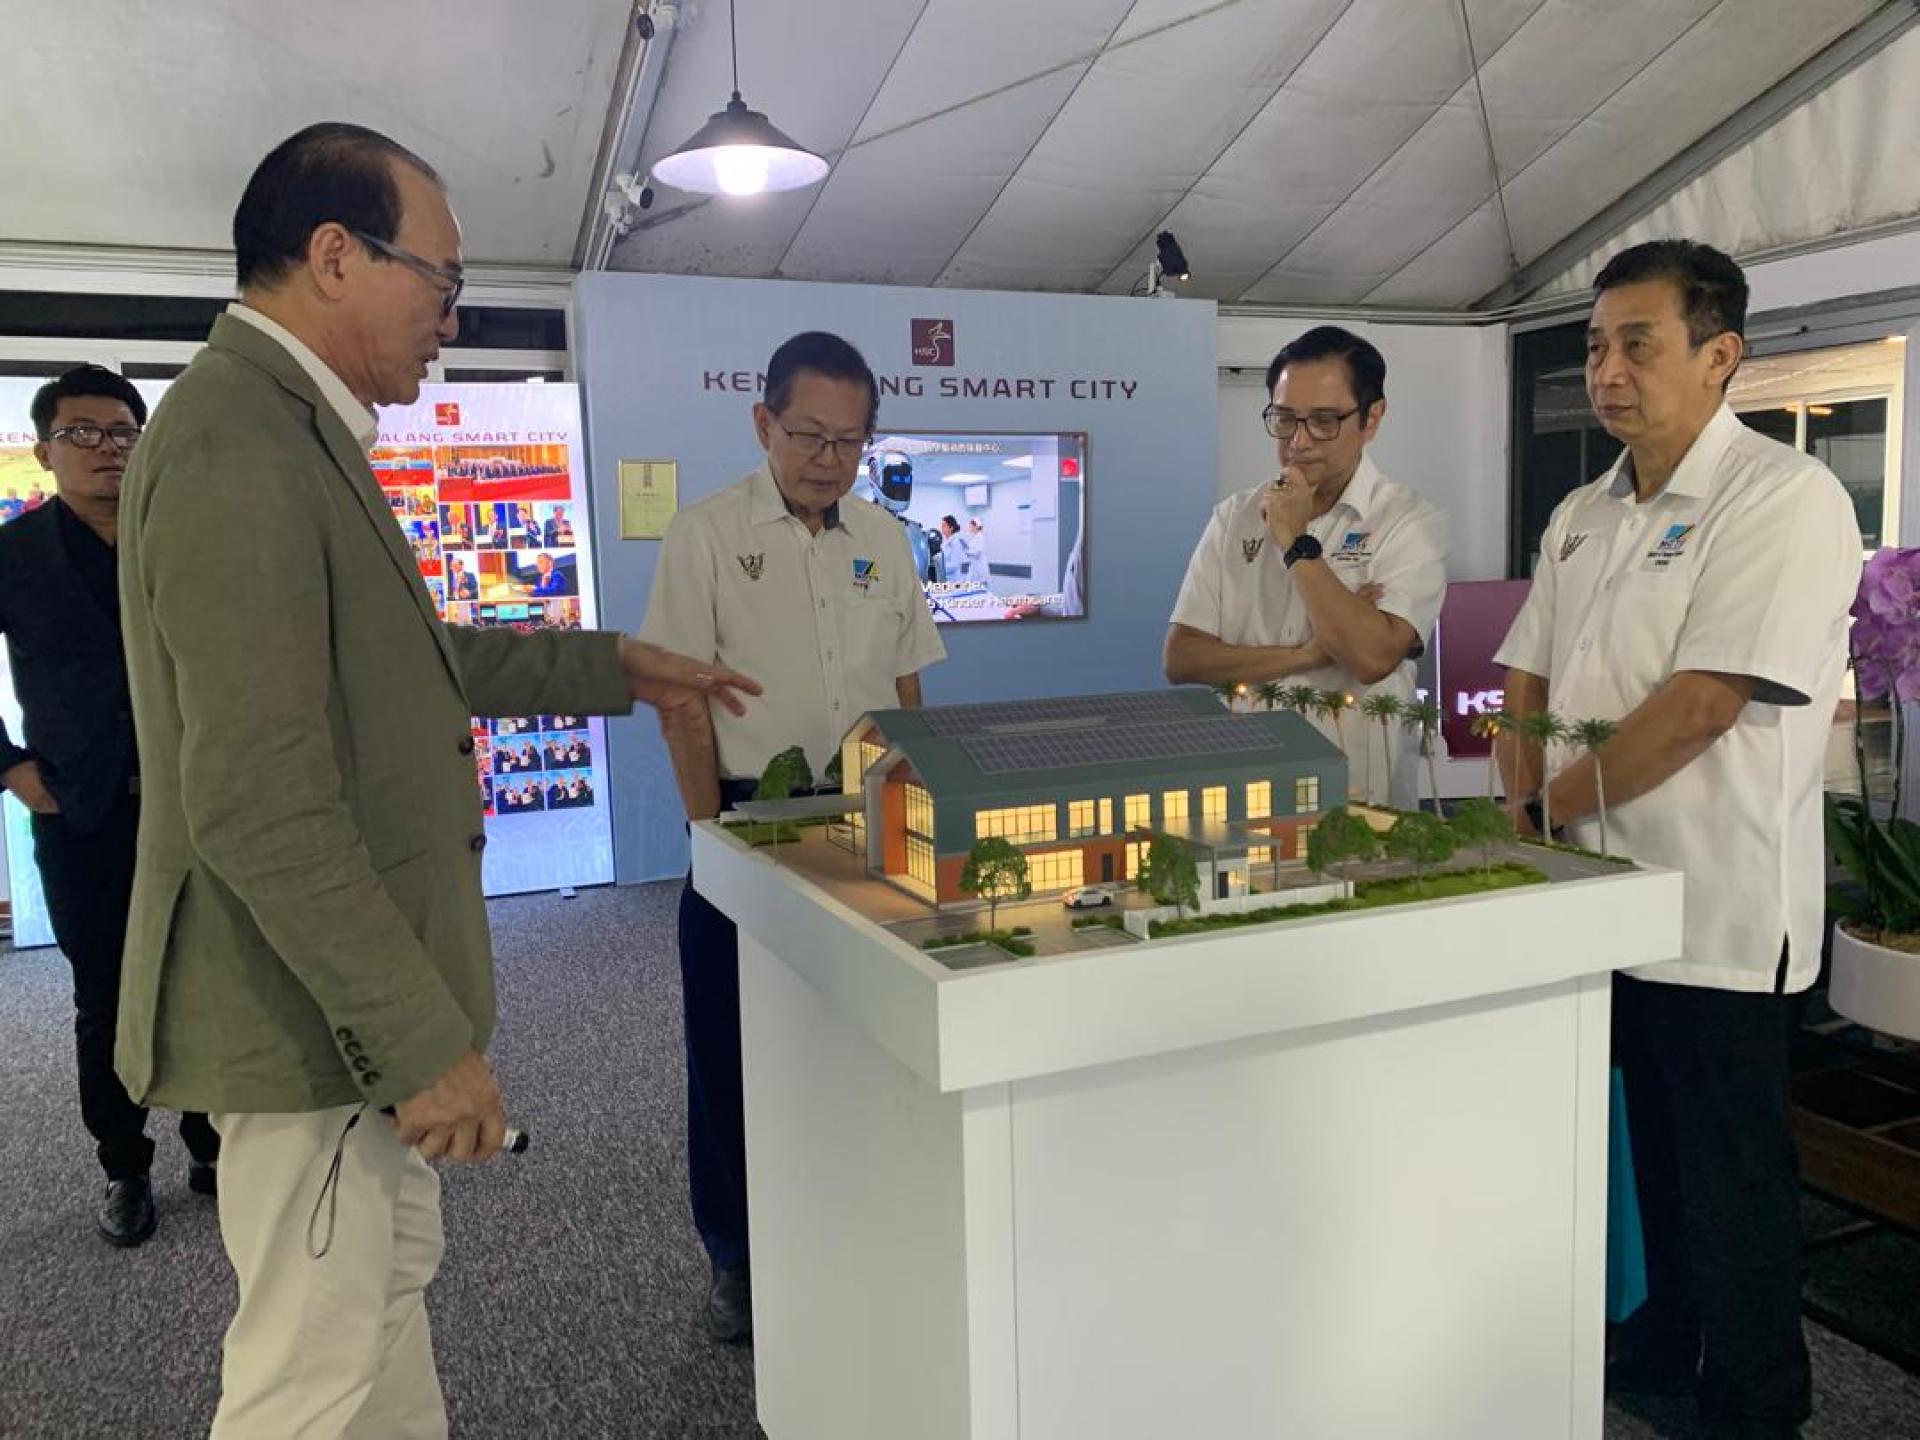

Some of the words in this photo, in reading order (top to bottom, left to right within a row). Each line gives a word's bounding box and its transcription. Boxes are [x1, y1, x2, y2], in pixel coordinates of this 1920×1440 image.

[703, 371, 924, 397] KENNG
[939, 377, 1056, 399] SMART
[1069, 379, 1138, 400] CITY
[452, 431, 518, 442] SMART
[527, 431, 568, 442] CITY
